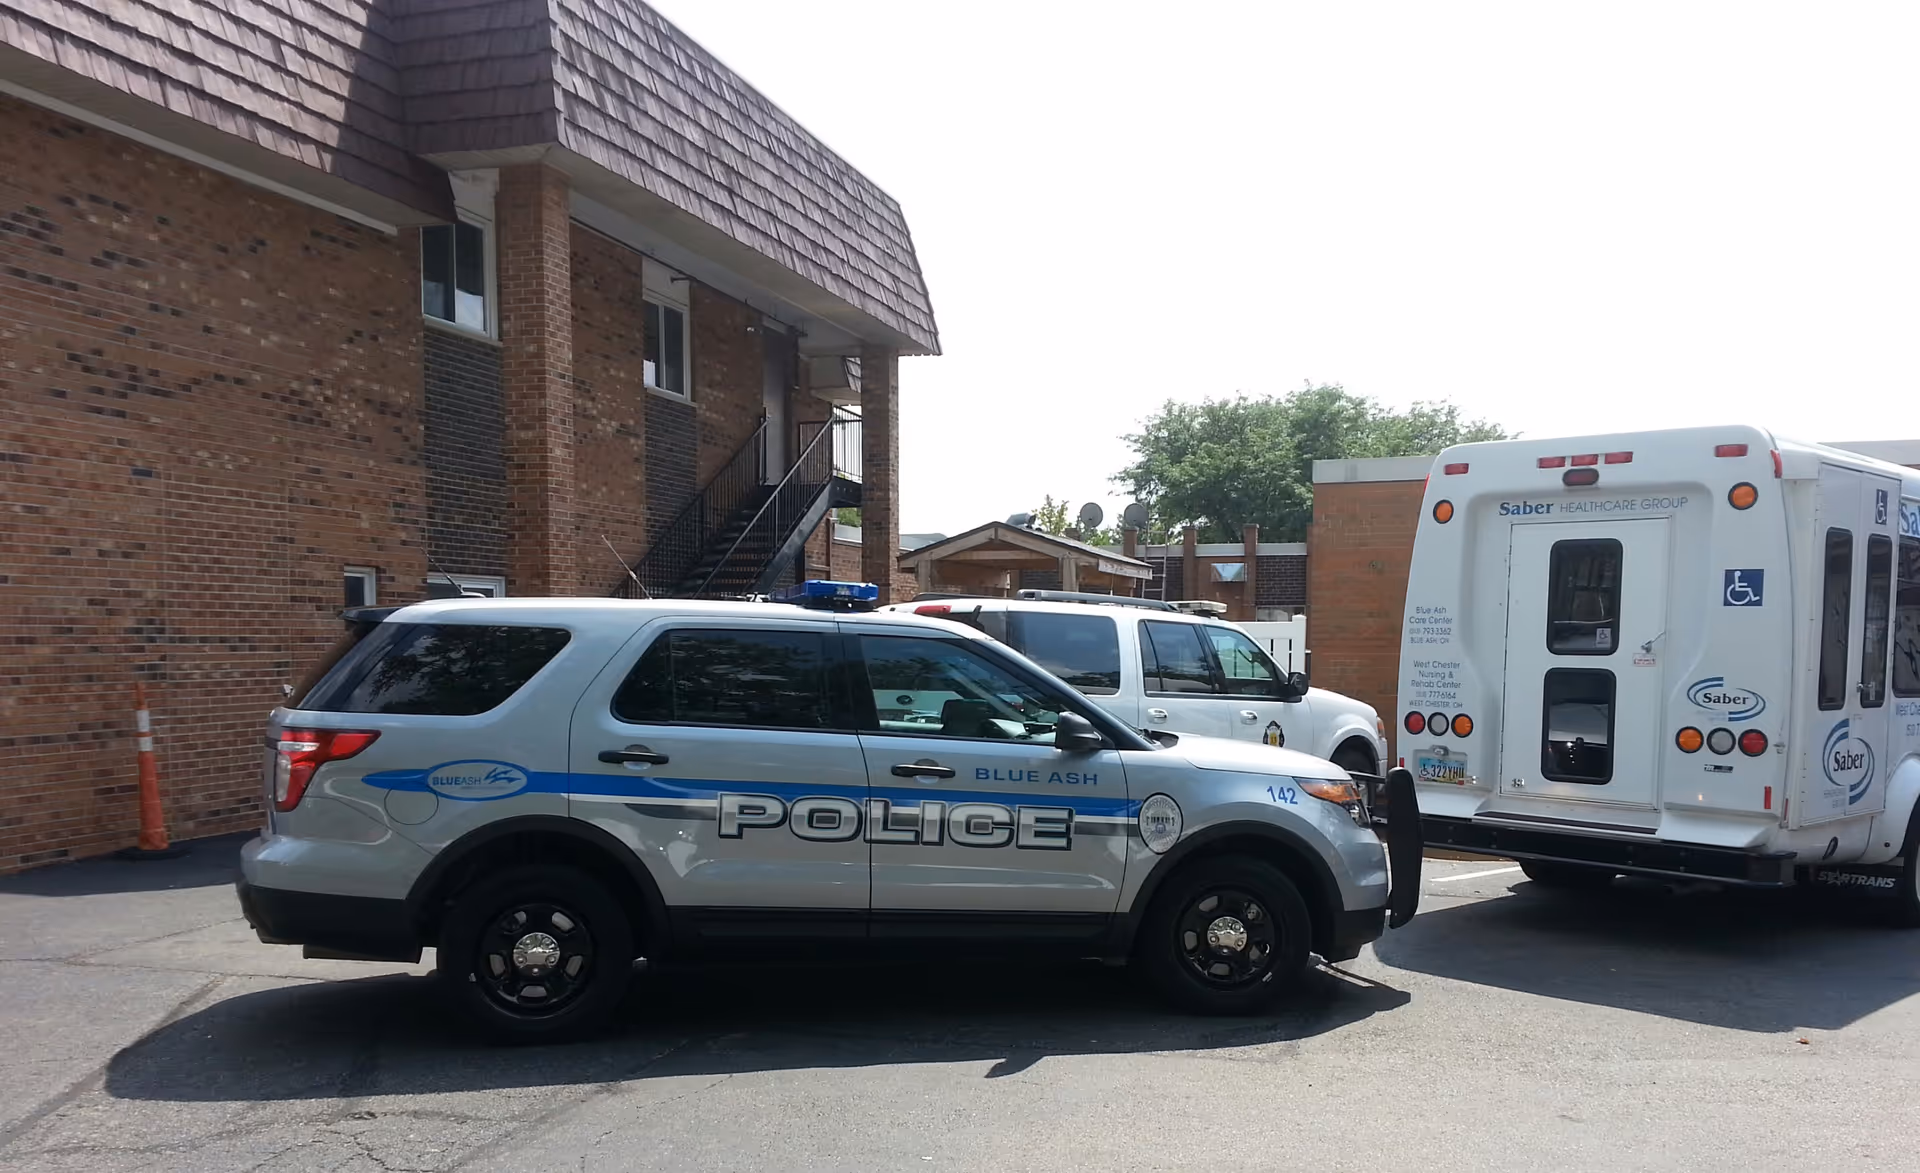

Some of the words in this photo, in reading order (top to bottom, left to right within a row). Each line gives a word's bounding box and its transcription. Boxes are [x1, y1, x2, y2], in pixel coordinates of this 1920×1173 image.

[1499, 501, 1554, 516] Saber
[1560, 499, 1636, 514] HEALTHCARE
[1640, 497, 1689, 511] GROUP
[1900, 501, 1920, 537] Sa
[1416, 606, 1431, 614] Blue
[1433, 606, 1447, 614] Ash
[1409, 616, 1427, 624] Care
[1428, 616, 1453, 625] Center
[1413, 660, 1430, 668] West
[1432, 661, 1461, 669] Chester
[1418, 670, 1446, 680] Nursing
[1448, 671, 1454, 679] &
[1411, 680, 1434, 688] Rehab
[1436, 680, 1461, 689] Center
[1453, 701, 1463, 709] OH
[1702, 692, 1749, 705] Saber
[1833, 751, 1865, 772] Saber
[975, 768, 1040, 784] BLUE
[1047, 770, 1099, 786] ASH
[1267, 785, 1299, 805] 142
[717, 791, 1076, 851] POLICE
